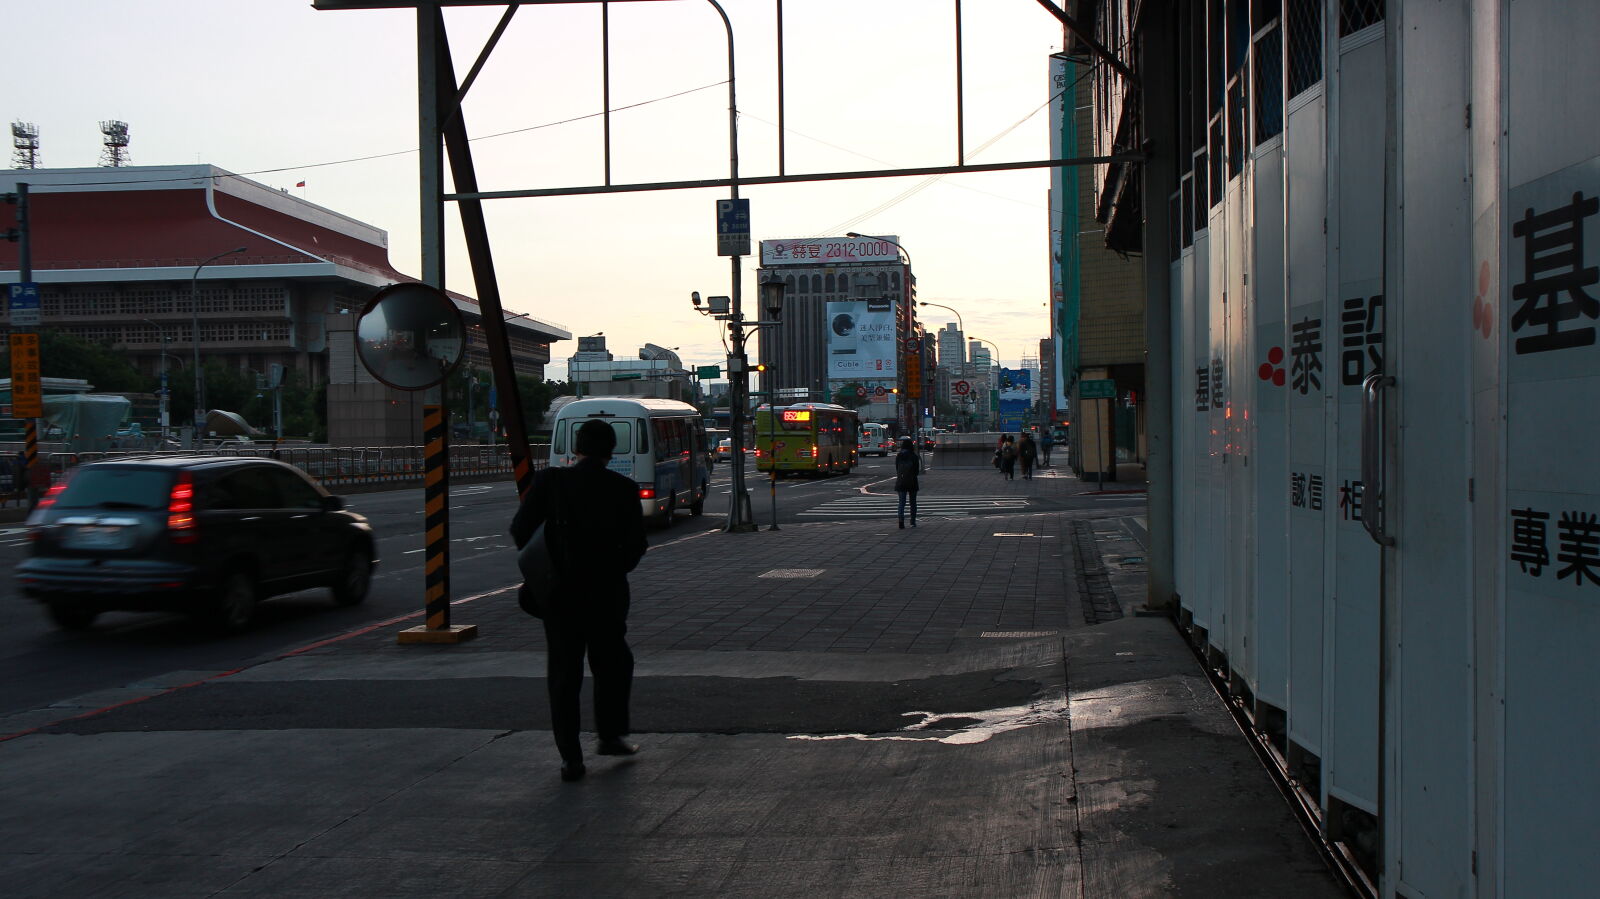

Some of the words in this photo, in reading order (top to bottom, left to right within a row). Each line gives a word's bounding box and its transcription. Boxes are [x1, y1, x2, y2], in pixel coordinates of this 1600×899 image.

[720, 201, 734, 219] P
[826, 241, 889, 258] 2312-0000
[1511, 190, 1600, 356] 基
[12, 285, 23, 298] P
[1511, 507, 1600, 587] 專業
